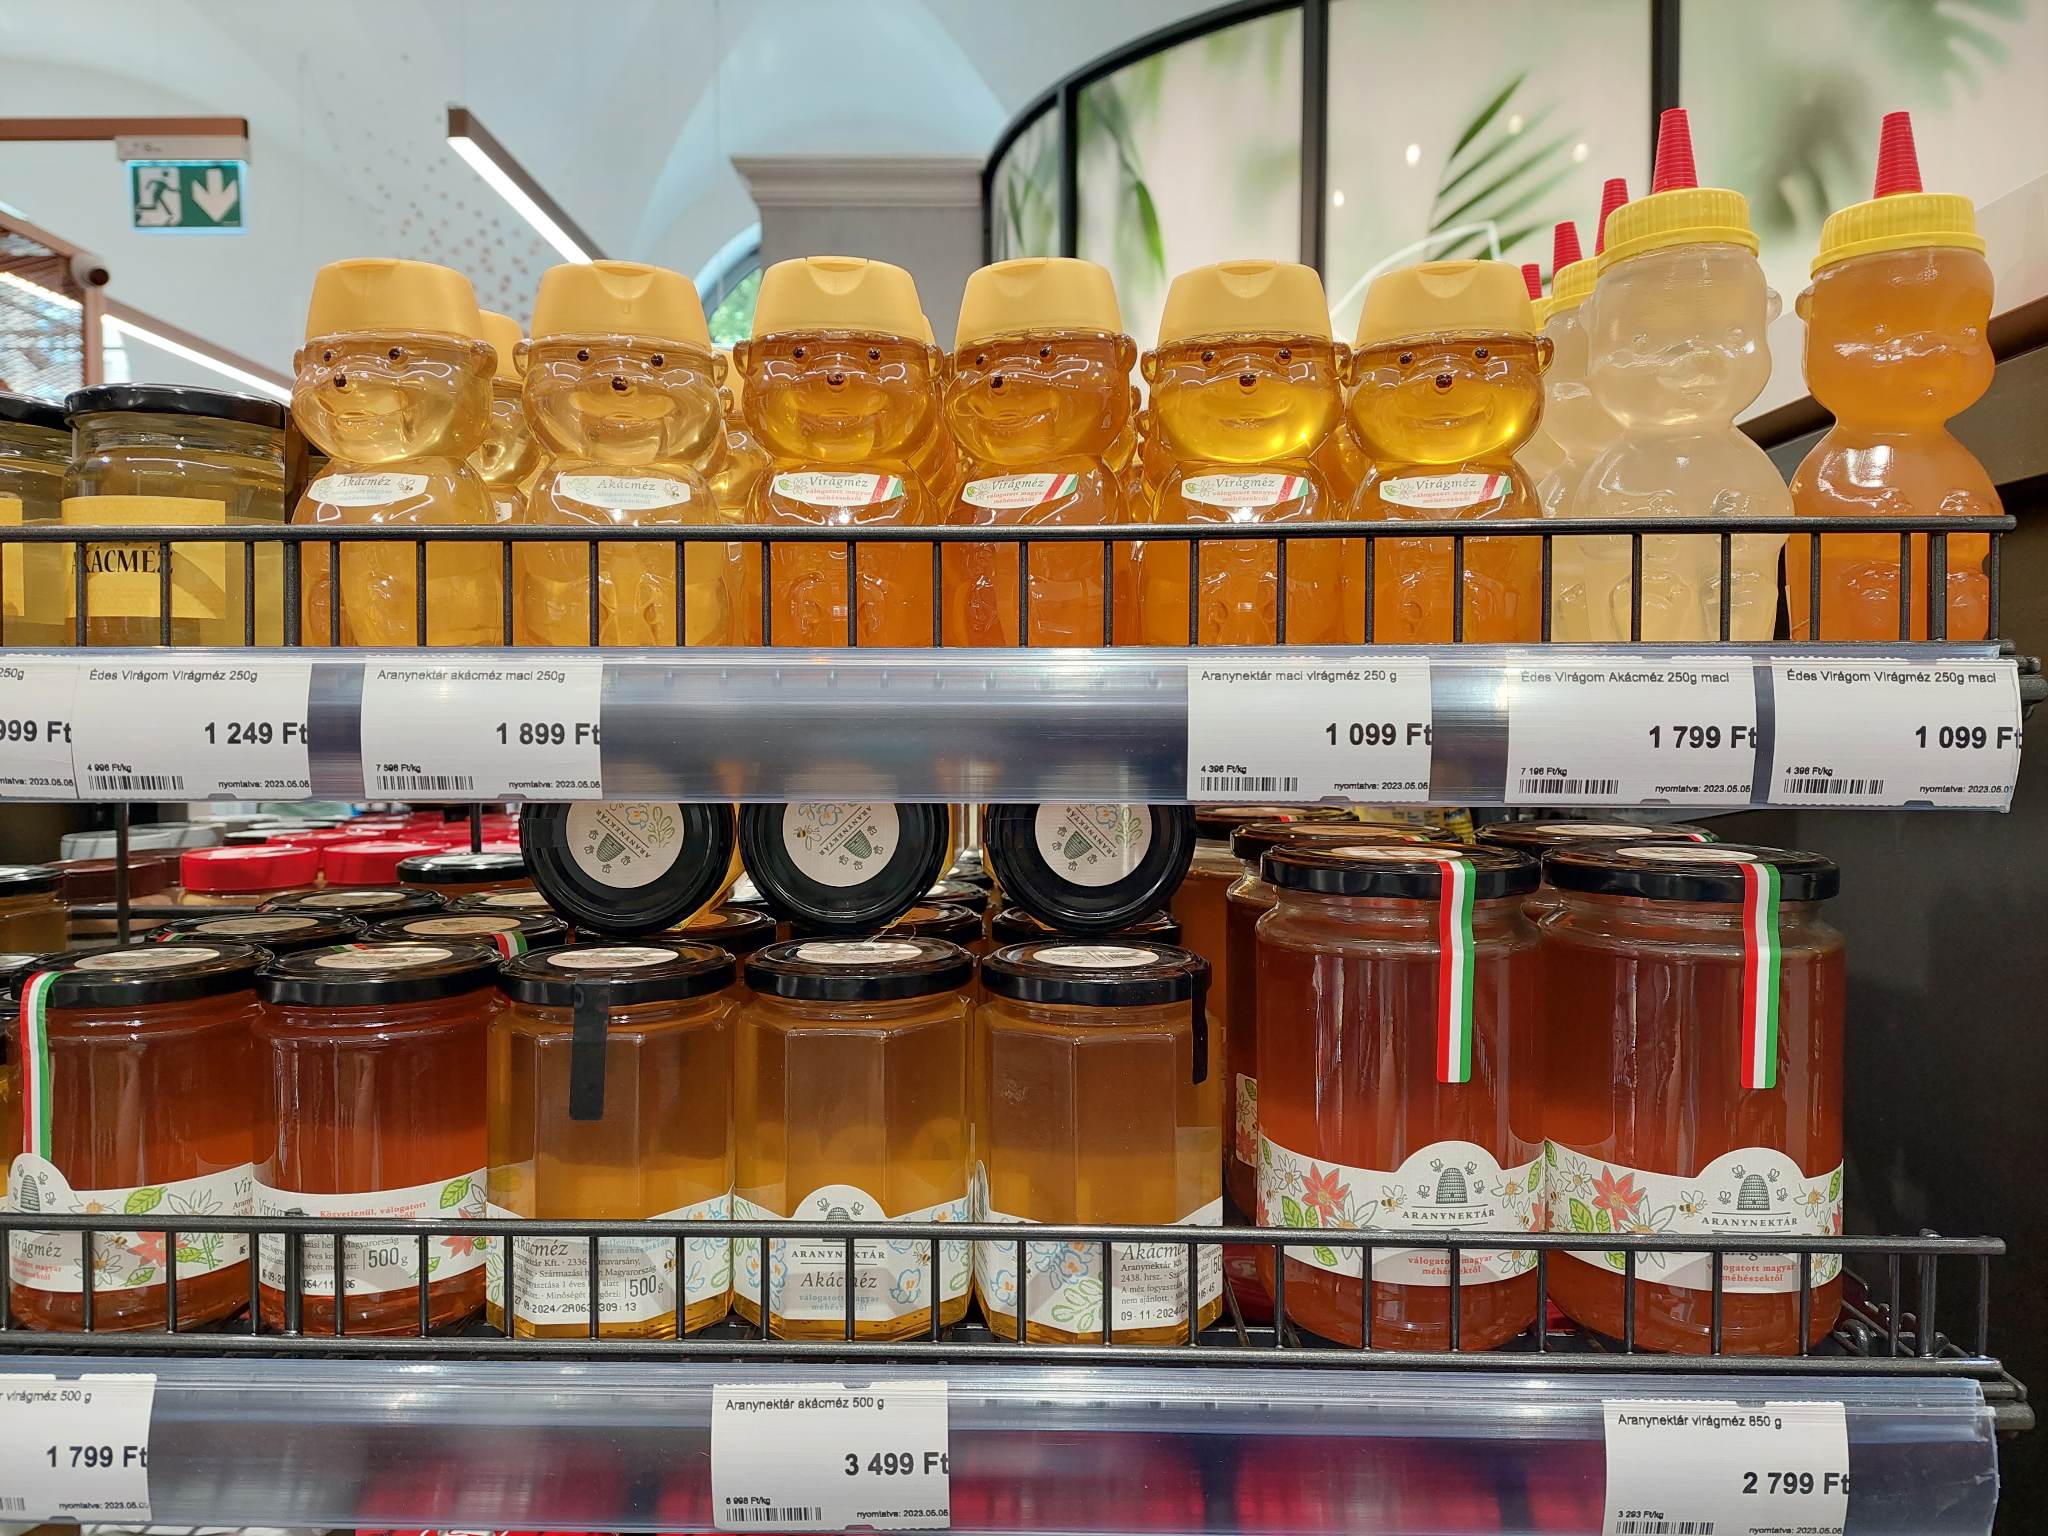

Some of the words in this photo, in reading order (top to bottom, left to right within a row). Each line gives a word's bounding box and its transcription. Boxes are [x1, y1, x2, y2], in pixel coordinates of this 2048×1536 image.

[597, 479, 656, 491] Akácméz
[992, 477, 1045, 491] Virágméz
[1215, 477, 1276, 489] Virágméz
[89, 669, 118, 681] Édes
[121, 670, 168, 683] Virágom
[172, 670, 226, 683] Virágméz
[229, 671, 258, 683] 250g
[377, 669, 448, 683] Aranynektár
[451, 670, 502, 681] akácméz
[506, 671, 533, 681] maci
[536, 671, 565, 683] 250g
[1201, 670, 1272, 684] Aranynektár
[1275, 671, 1303, 681] maci
[1306, 671, 1361, 683] virágméz
[1364, 671, 1386, 681] 250
[1390, 673, 1397, 682] g
[1521, 670, 1552, 682] Édes
[1555, 671, 1605, 684] Virágom
[1608, 671, 1664, 683] Akácméz
[1667, 672, 1698, 685] 250g
[1701, 672, 1730, 683] maci
[1787, 669, 1817, 682] Édes
[1820, 671, 1870, 684] Virágom
[1874, 672, 1931, 684] Virágméz
[1935, 672, 1964, 685] 250g
[1968, 672, 1997, 683] maci
[47, 720, 71, 743] Ft
[204, 721, 215, 744] 1
[227, 721, 273, 745] 249
[282, 721, 308, 745] Ft
[496, 722, 507, 745] 1
[519, 722, 565, 745] 899
[575, 722, 600, 745] Ft
[1325, 722, 1337, 746] 1
[1350, 722, 1397, 746] 099
[1406, 722, 1432, 746] Ft
[1649, 725, 1660, 748] 1
[1673, 725, 1721, 748] 799
[1731, 725, 1757, 748] Ft
[1915, 725, 1927, 748] 1
[1939, 726, 1987, 749] 099
[1997, 726, 2022, 749] Ft
[111, 763, 132, 774] Ft/kg
[376, 764, 381, 772] 7
[400, 763, 421, 774] Ft/kg
[1201, 765, 1206, 773] 4
[1226, 765, 1247, 775] Ft/kg
[1521, 767, 1526, 775] 7
[1546, 766, 1567, 777] Ft/kg
[1785, 767, 1792, 775] 4
[1811, 766, 1833, 777] Ft/kg
[1402, 1208, 1495, 1220] ARANYNEKTÁR
[1701, 1215, 1798, 1227] ARANYNEKTÁR
[368, 1246, 399, 1268] 500
[400, 1256, 409, 1266] g
[791, 1250, 886, 1259] ARANYNKTÁR
[567, 1257, 588, 1267] 2336
[1706, 1263, 1760, 1273] vogatott
[1763, 1264, 1796, 1273] magyar
[629, 1275, 657, 1297] 500
[658, 1282, 664, 1293] g
[7, 1390, 57, 1404] virágméz
[60, 1391, 81, 1401] 500
[84, 1392, 92, 1404] g
[725, 1398, 795, 1413] Aranynektár
[798, 1398, 849, 1409] akácméz
[852, 1397, 873, 1408] 500
[877, 1399, 884, 1410] g
[1618, 1414, 1688, 1429] Aranynektár
[1692, 1415, 1746, 1429] virágméz
[1749, 1415, 1771, 1427] 850
[1775, 1418, 1782, 1429] g
[47, 1446, 57, 1468] 1
[69, 1446, 113, 1468] 799
[123, 1446, 148, 1468] Ft
[845, 1453, 859, 1476] 3
[867, 1453, 914, 1476] 499
[924, 1452, 948, 1475] Ft
[1742, 1472, 1758, 1494] 2
[1767, 1472, 1814, 1495] 799
[1824, 1473, 1850, 1495] Ft
[750, 1496, 771, 1506] Ft/kg
[1643, 1510, 1664, 1520] Ft/kg
